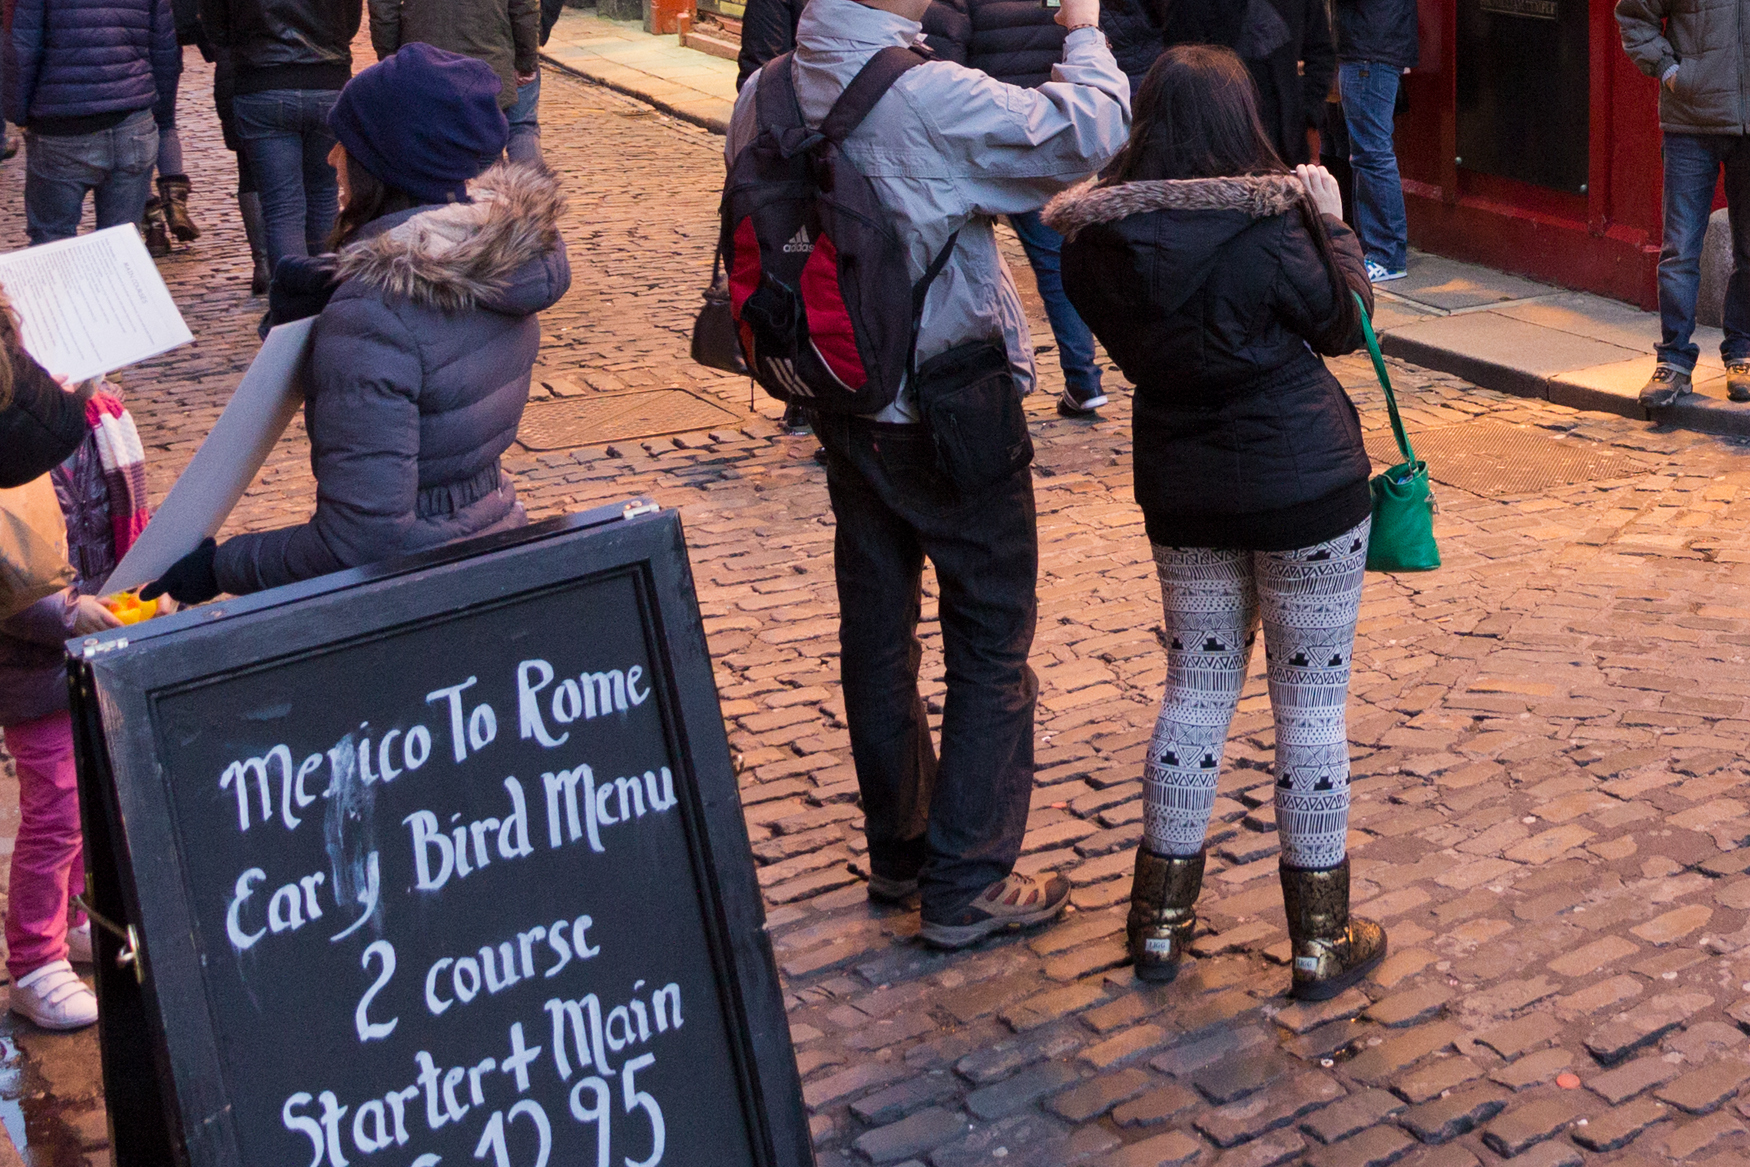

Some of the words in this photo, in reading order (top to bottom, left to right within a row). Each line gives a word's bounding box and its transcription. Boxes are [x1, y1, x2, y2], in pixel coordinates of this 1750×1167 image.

[426, 675, 498, 763] To
[517, 659, 651, 748] Rome
[226, 850, 380, 949] Eary
[402, 775, 535, 892] Bird
[541, 763, 678, 852] Menu
[355, 939, 399, 1041] 2
[425, 914, 601, 1015] course
[282, 1050, 497, 1167] Starter
[544, 979, 684, 1082] Main
